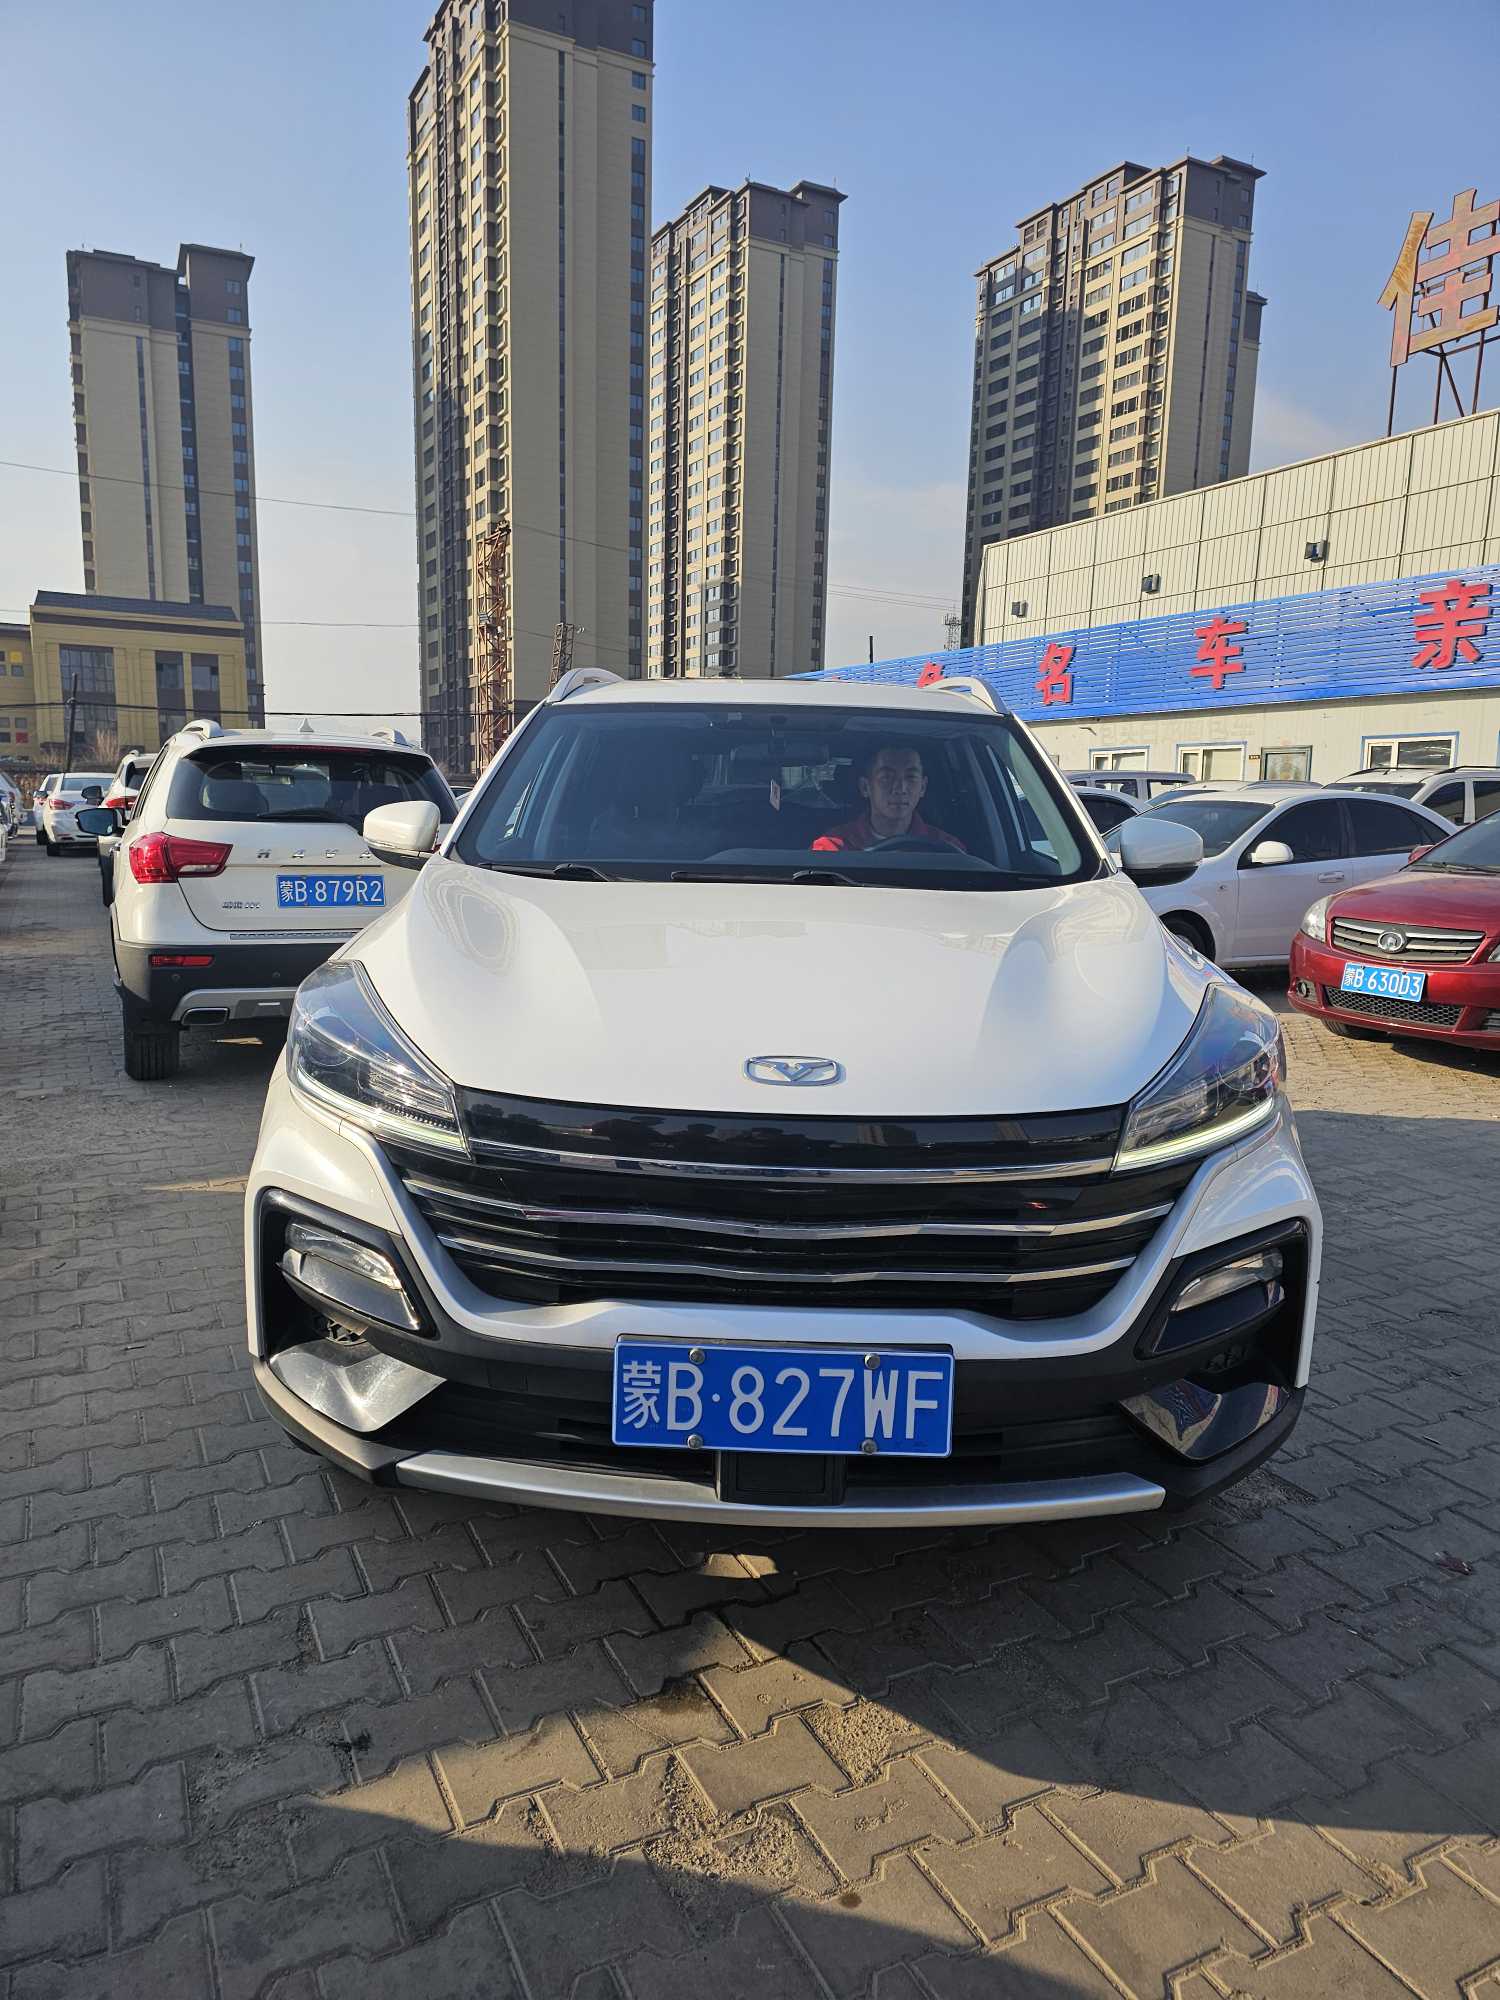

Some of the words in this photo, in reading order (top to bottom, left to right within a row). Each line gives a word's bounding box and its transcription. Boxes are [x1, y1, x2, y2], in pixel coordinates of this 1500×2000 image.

[257, 849, 373, 858] HAVA
[279, 880, 382, 902] 蒙B·879R2
[622, 1361, 944, 1440] 蒙B·827WF
